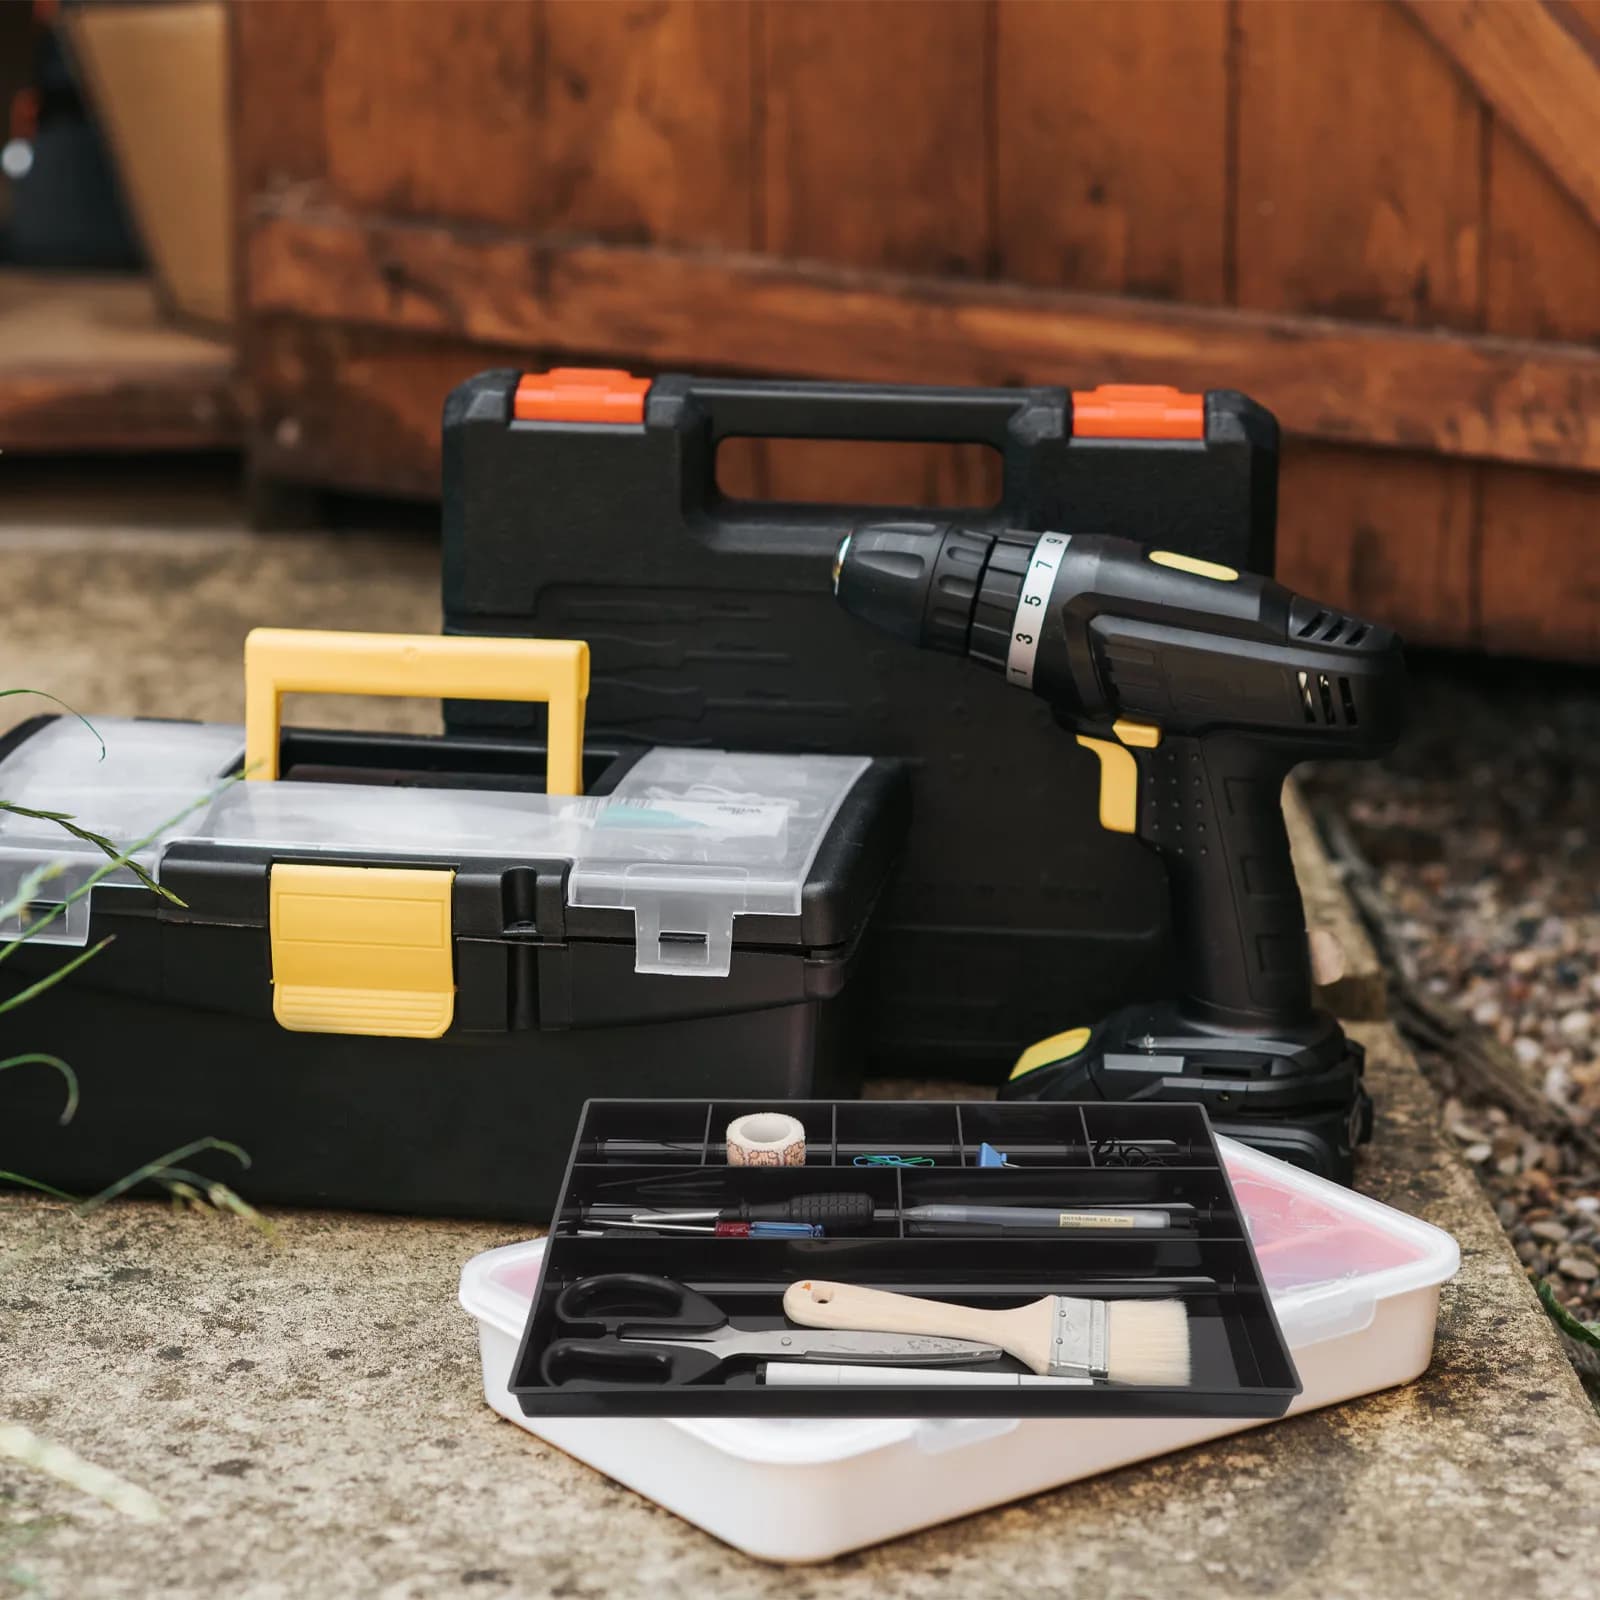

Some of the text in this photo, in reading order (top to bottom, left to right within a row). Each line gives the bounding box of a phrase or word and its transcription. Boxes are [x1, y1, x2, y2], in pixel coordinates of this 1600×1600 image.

[1035, 560, 1053, 569] 7
[1024, 594, 1042, 607] 5
[1015, 632, 1033, 645] 3
[1011, 667, 1028, 676] 1
